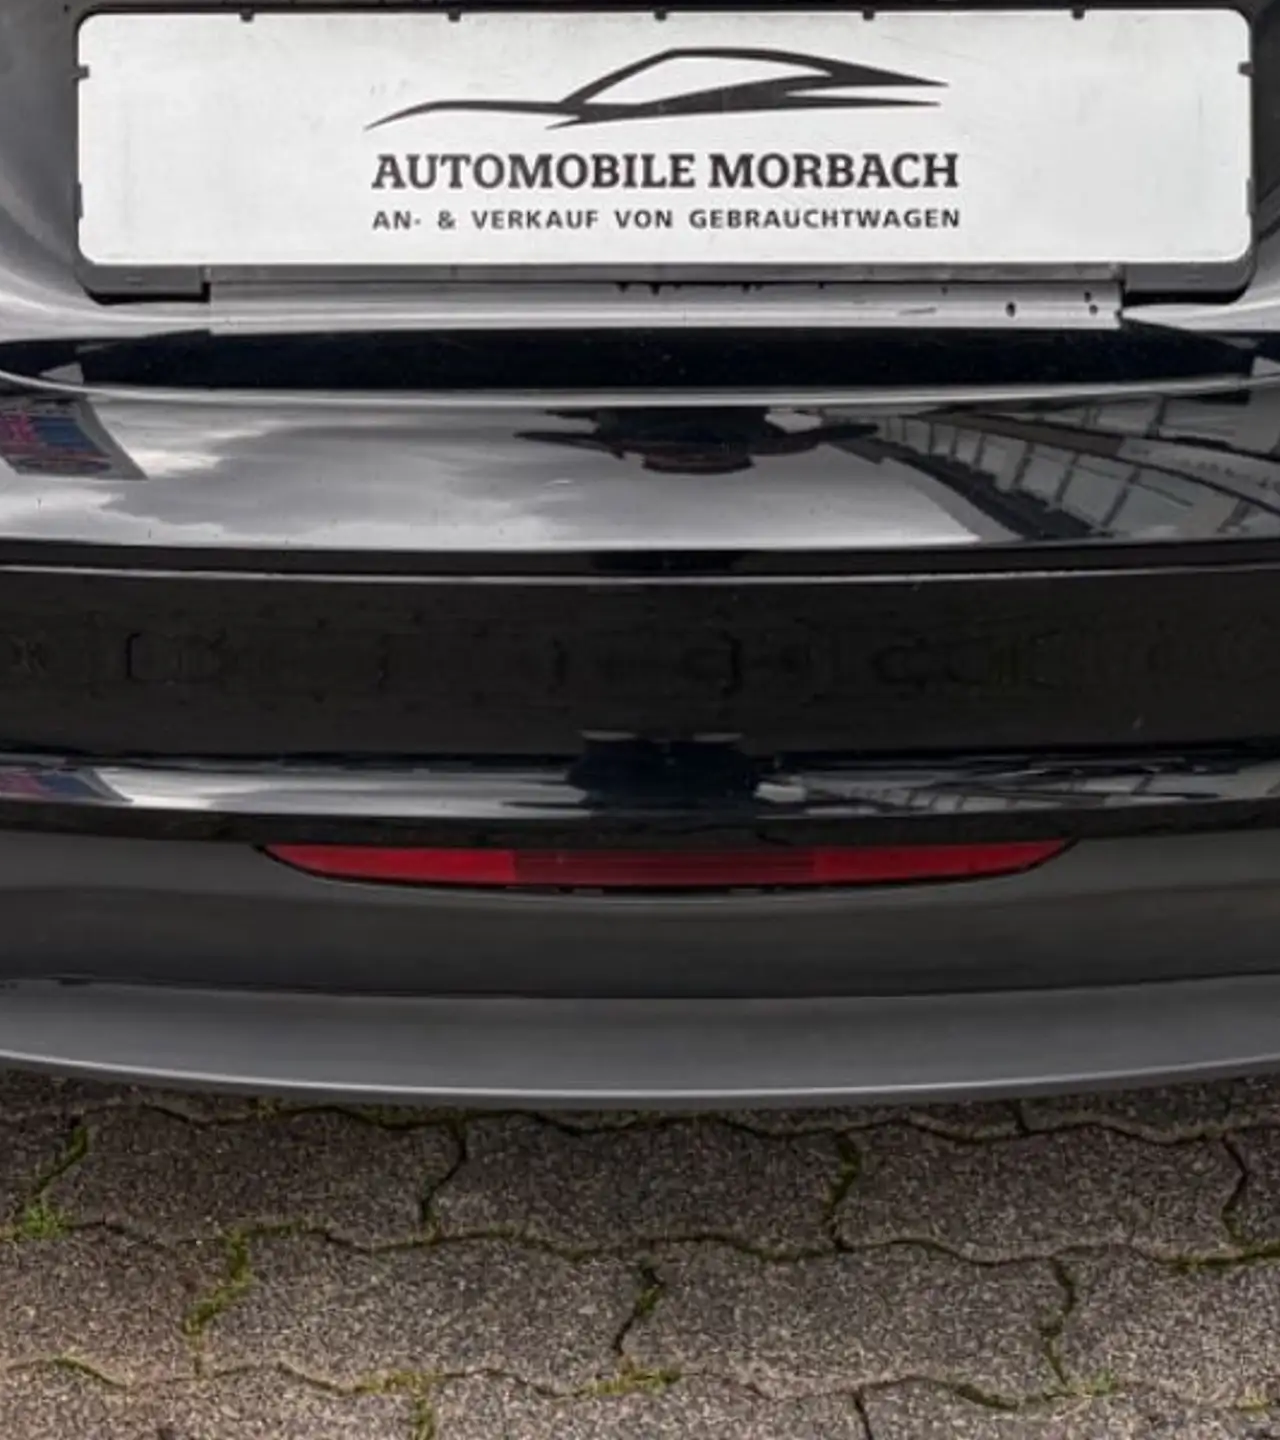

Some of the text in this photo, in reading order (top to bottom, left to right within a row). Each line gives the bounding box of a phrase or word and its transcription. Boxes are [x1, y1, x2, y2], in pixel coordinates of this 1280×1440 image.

[371, 152, 960, 189] AUTOMOBILE MORBACH
[372, 208, 960, 230] AN- & VERKAUF VON GEBRAUCHTWAGEN
